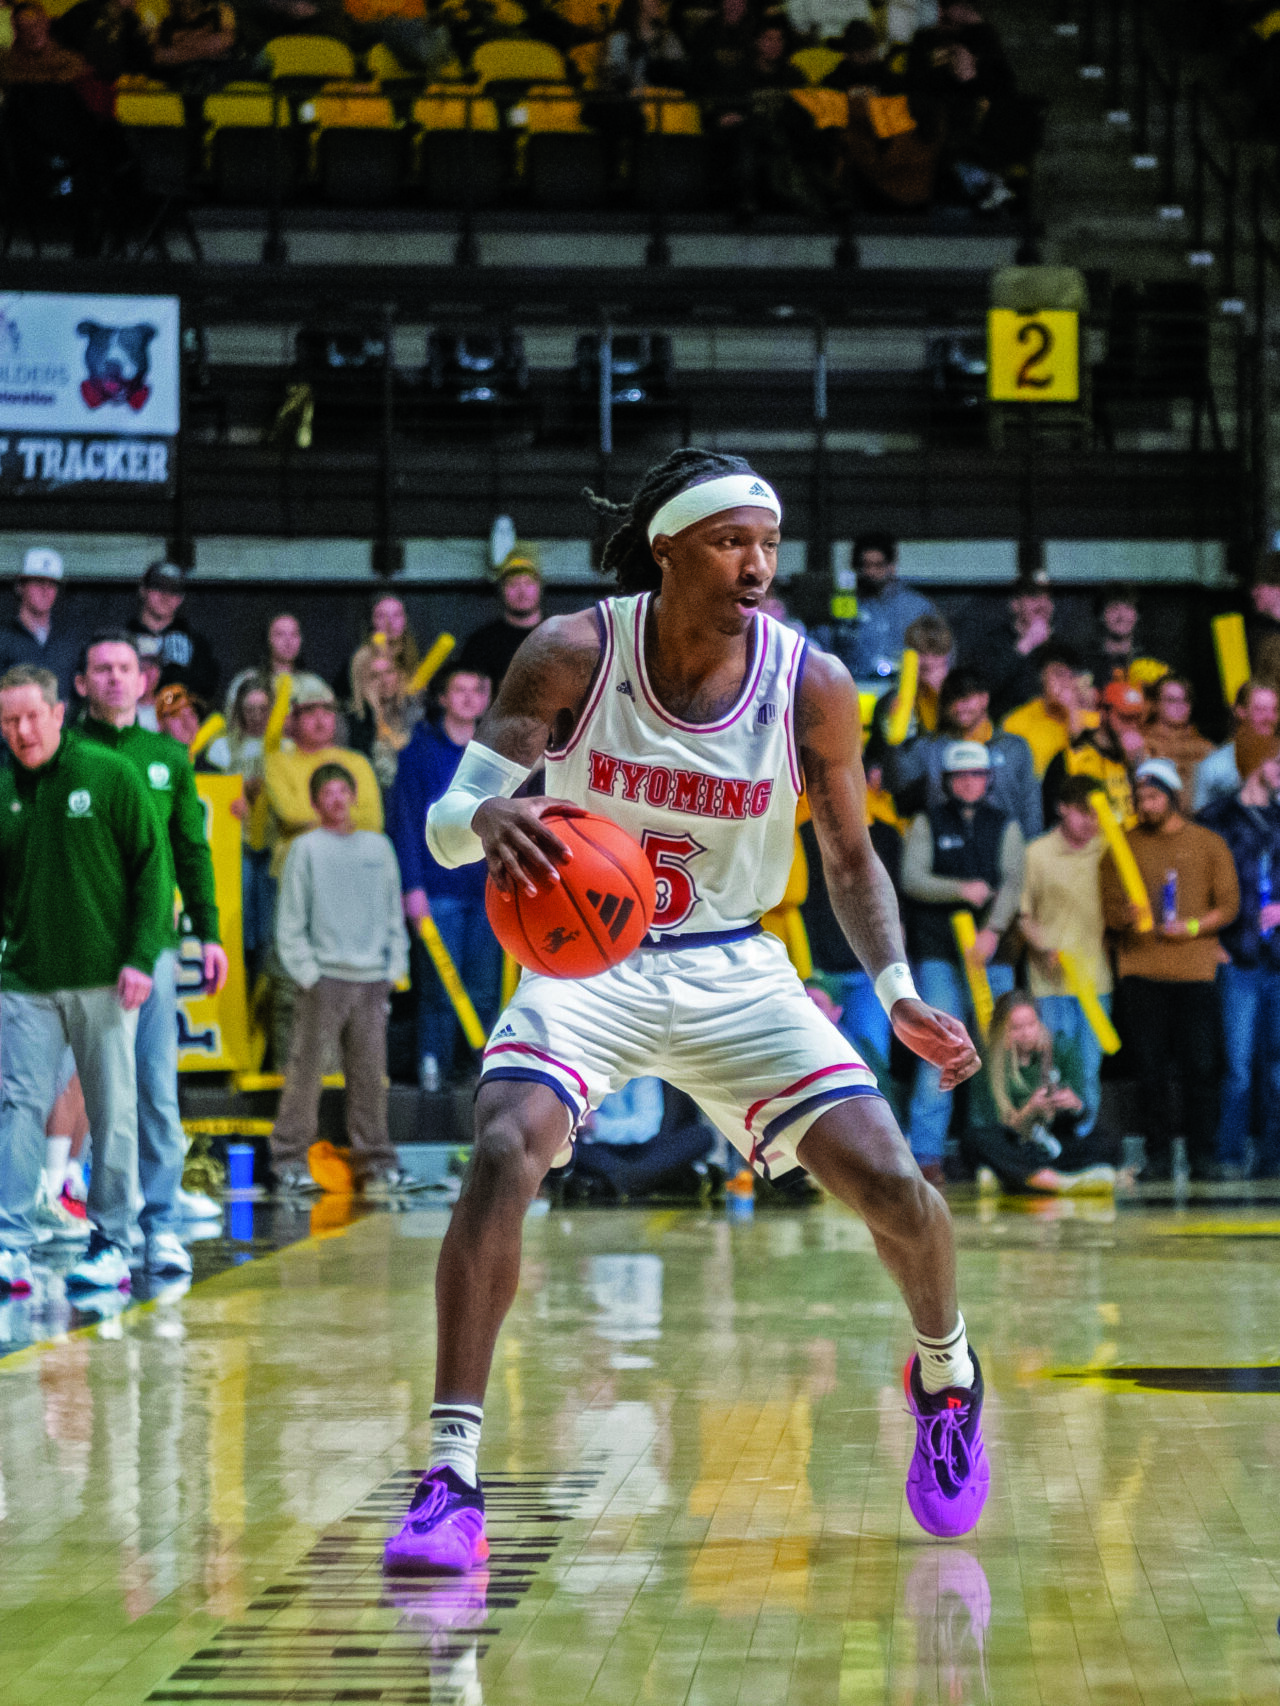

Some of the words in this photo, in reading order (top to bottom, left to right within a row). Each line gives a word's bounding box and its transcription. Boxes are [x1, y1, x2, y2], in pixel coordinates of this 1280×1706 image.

[1016, 323, 1055, 389] 2
[18, 440, 168, 483] TRACKER
[588, 749, 775, 820] WYOMING
